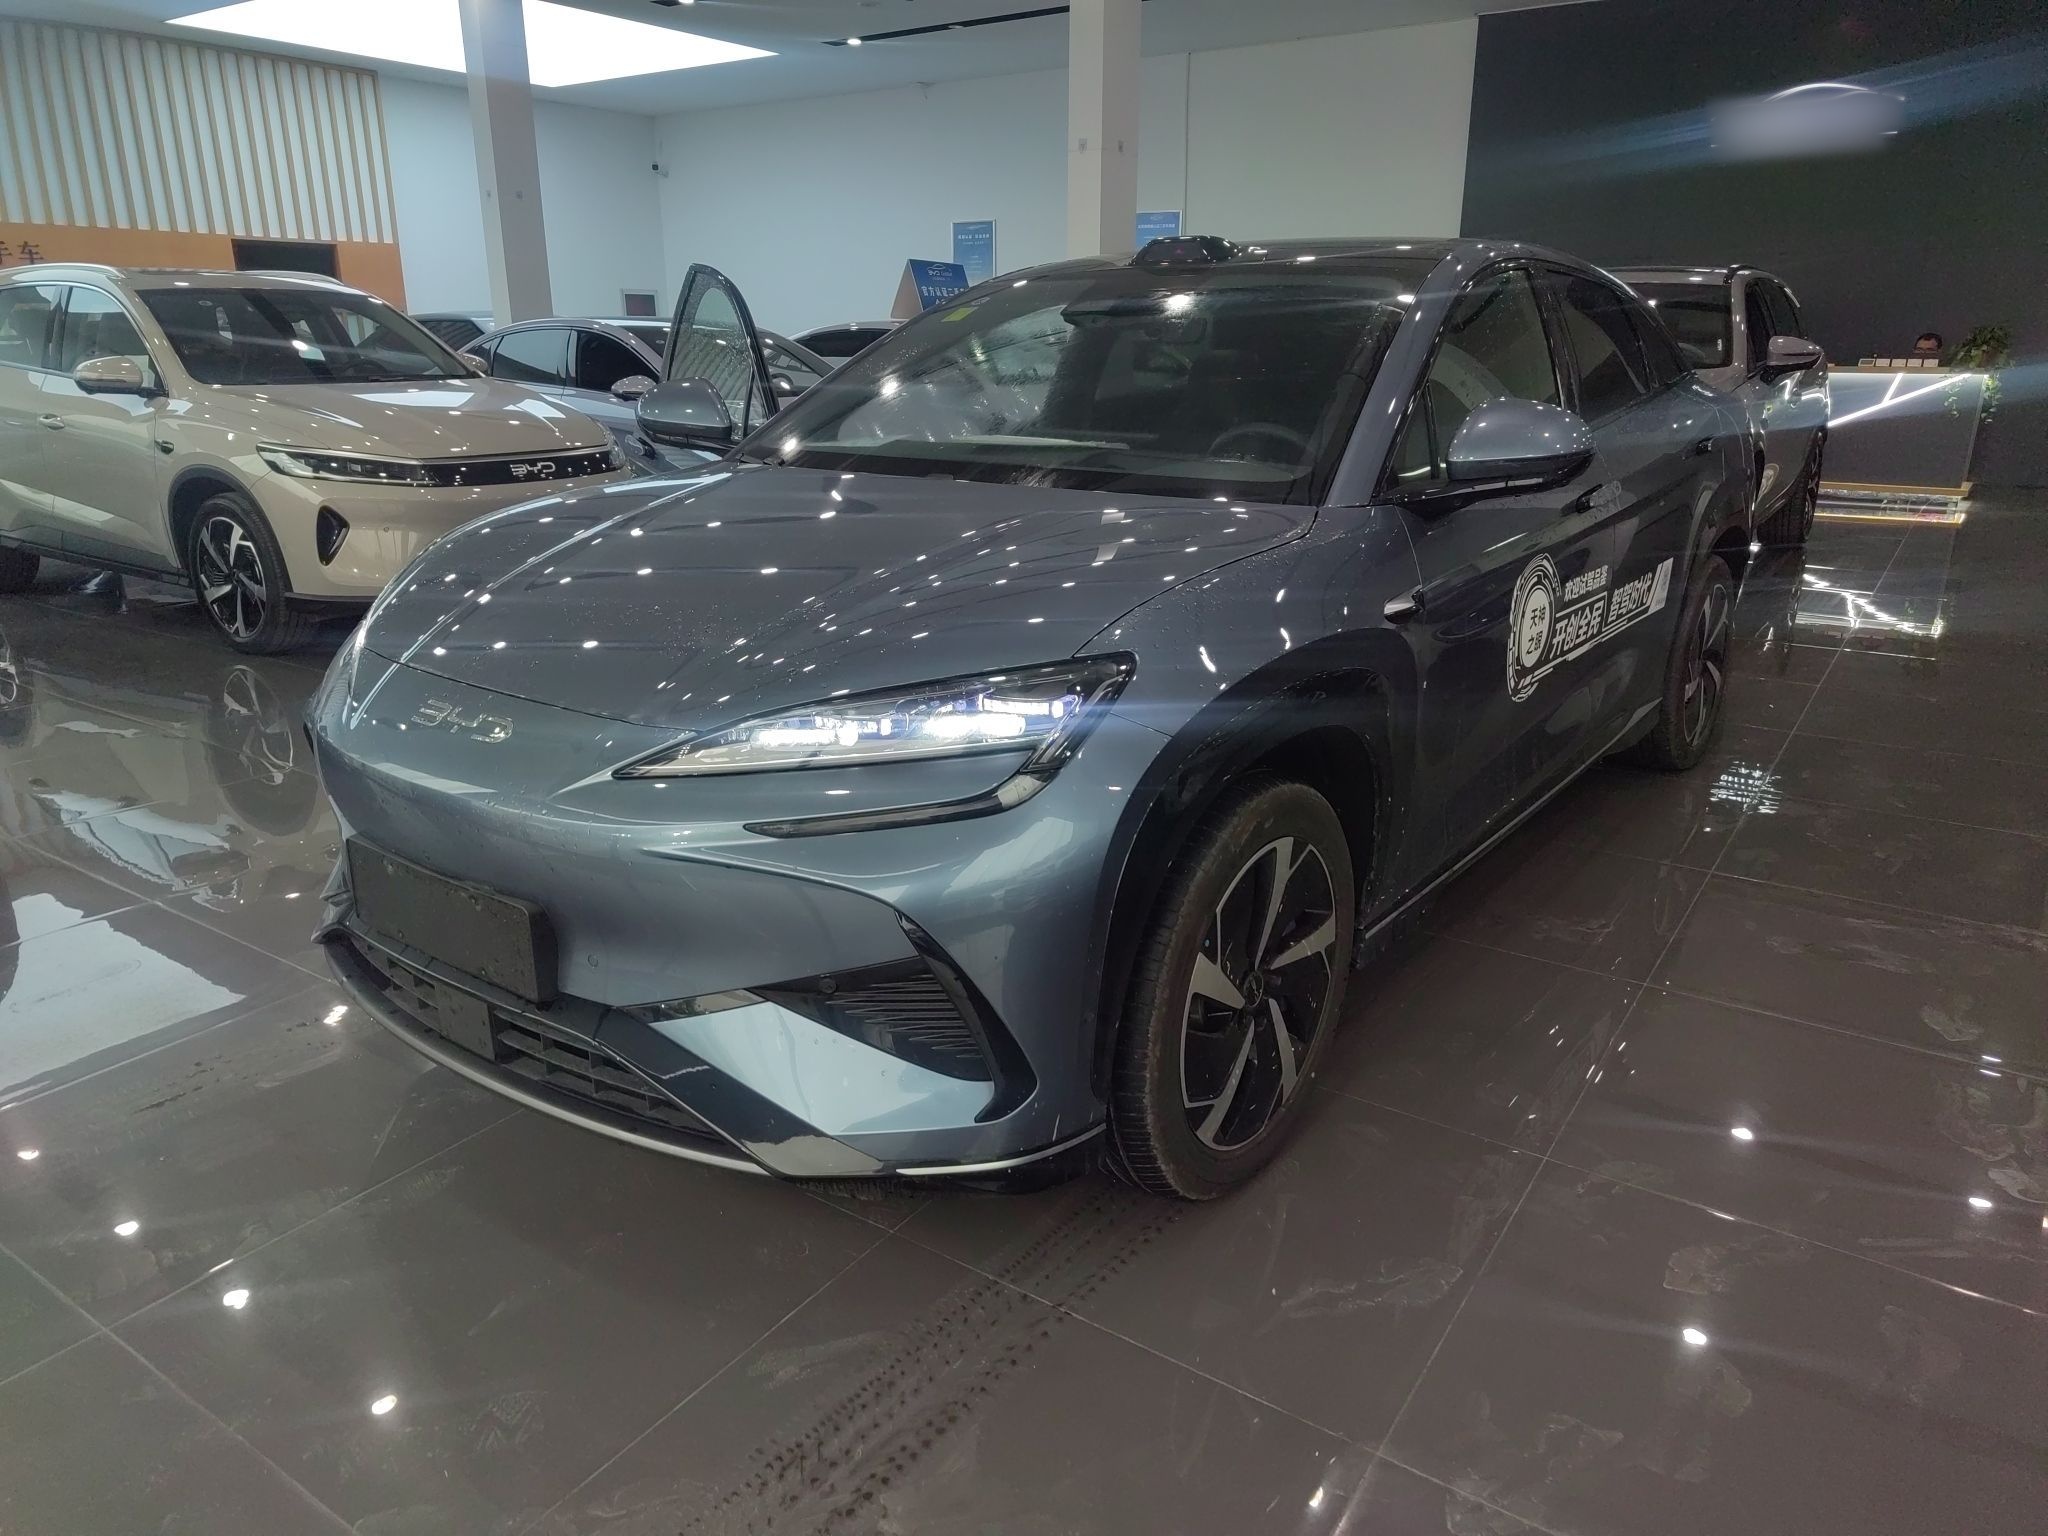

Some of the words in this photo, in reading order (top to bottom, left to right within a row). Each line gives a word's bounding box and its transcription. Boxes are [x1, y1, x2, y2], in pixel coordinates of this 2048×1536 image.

[510, 462, 556, 476] BYD
[1564, 565, 1608, 602] 欢迎试驾品鉴
[1530, 605, 1546, 630] 天神
[1550, 600, 1604, 659] 开创全民
[1607, 572, 1652, 624] 智驾时代
[1526, 630, 1543, 655] 之眼
[411, 699, 514, 744] BYD
